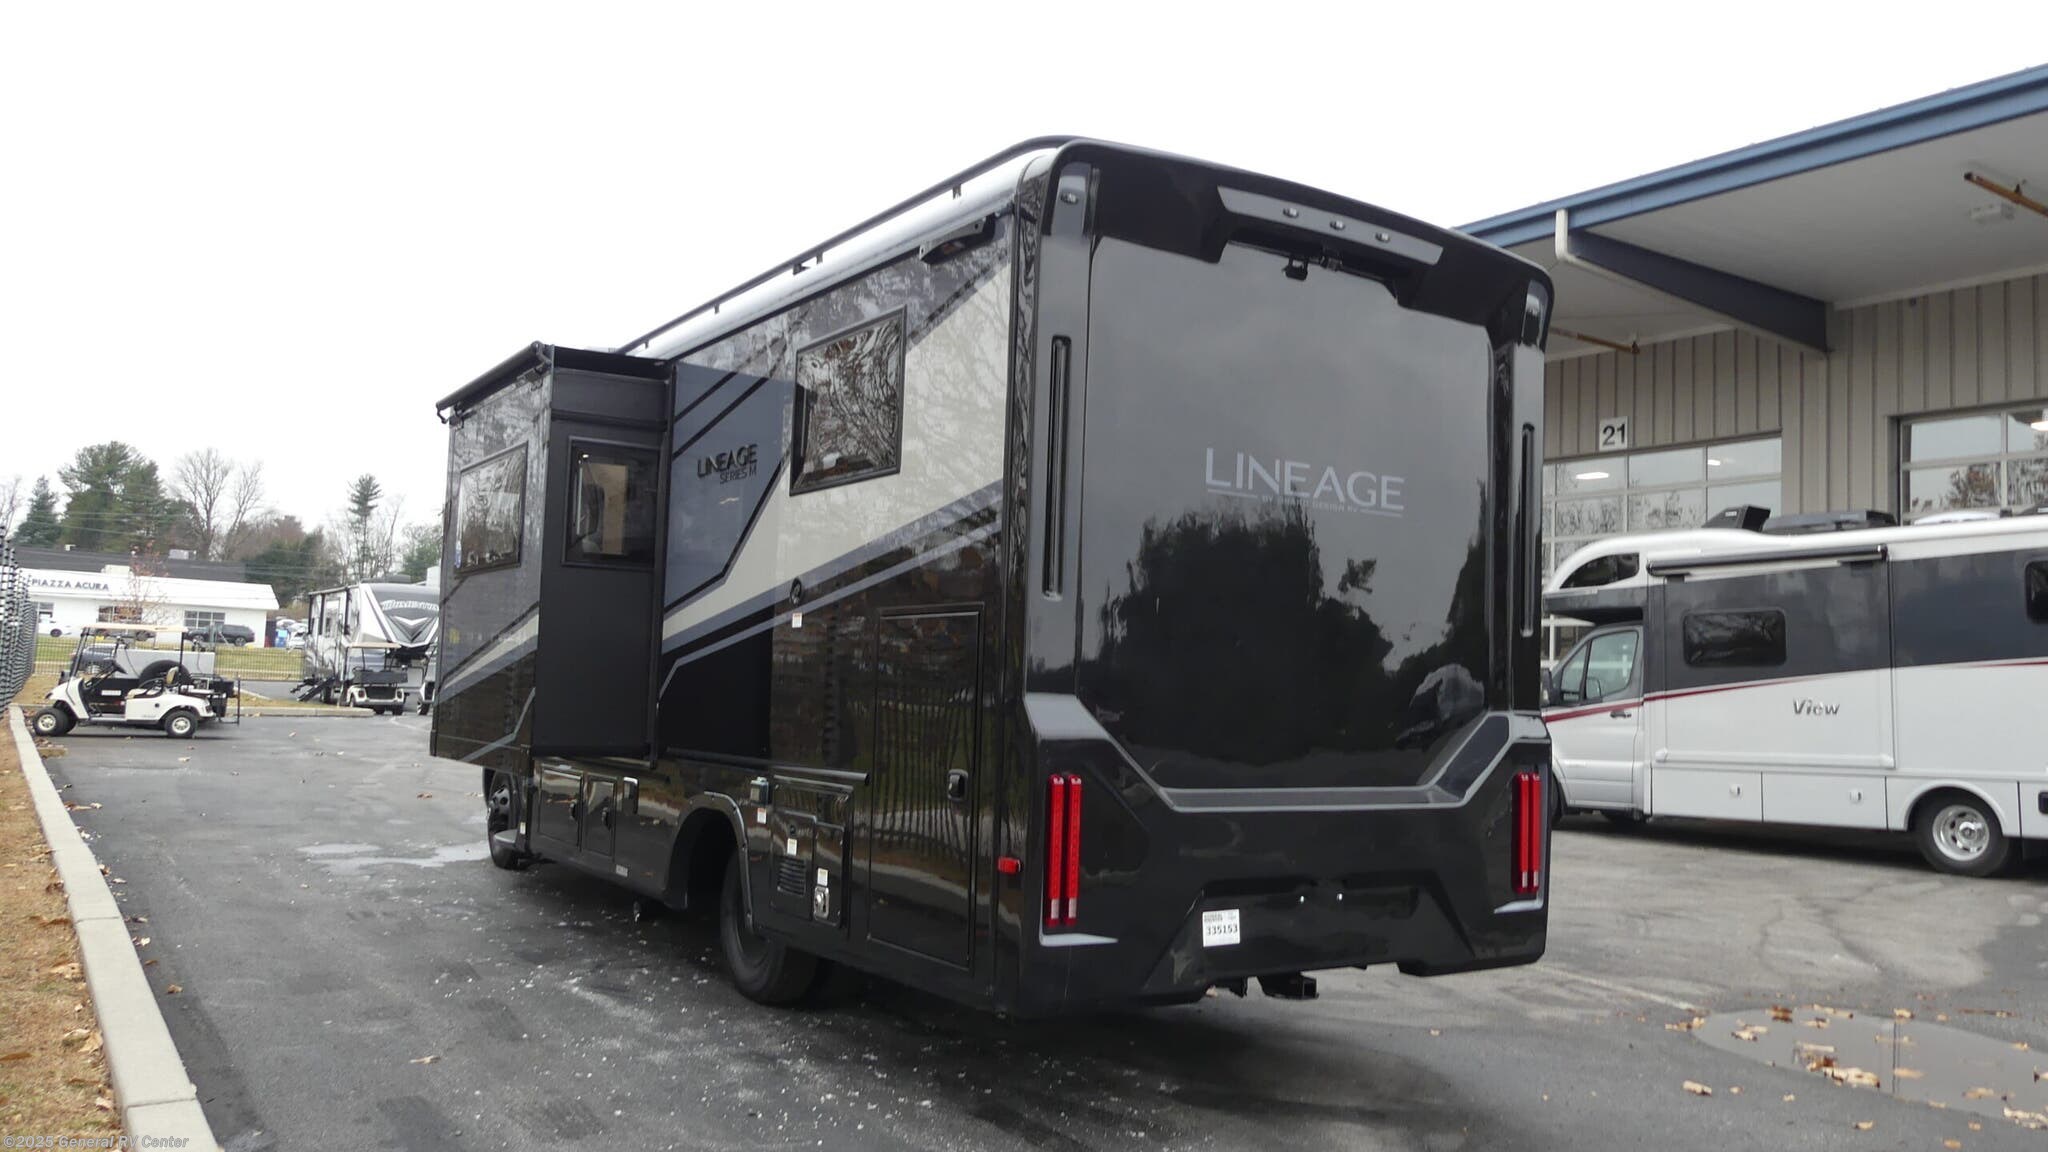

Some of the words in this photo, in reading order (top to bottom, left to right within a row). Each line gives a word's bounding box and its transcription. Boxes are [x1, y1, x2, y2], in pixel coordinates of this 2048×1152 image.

[1603, 423, 1626, 446] 21
[698, 444, 758, 478] LINEAGE
[720, 467, 748, 484] SERIES
[1206, 448, 1405, 511] LINEAGE
[32, 579, 72, 589] PIAZZA
[74, 582, 109, 591] ACURA
[1793, 699, 1841, 715] View
